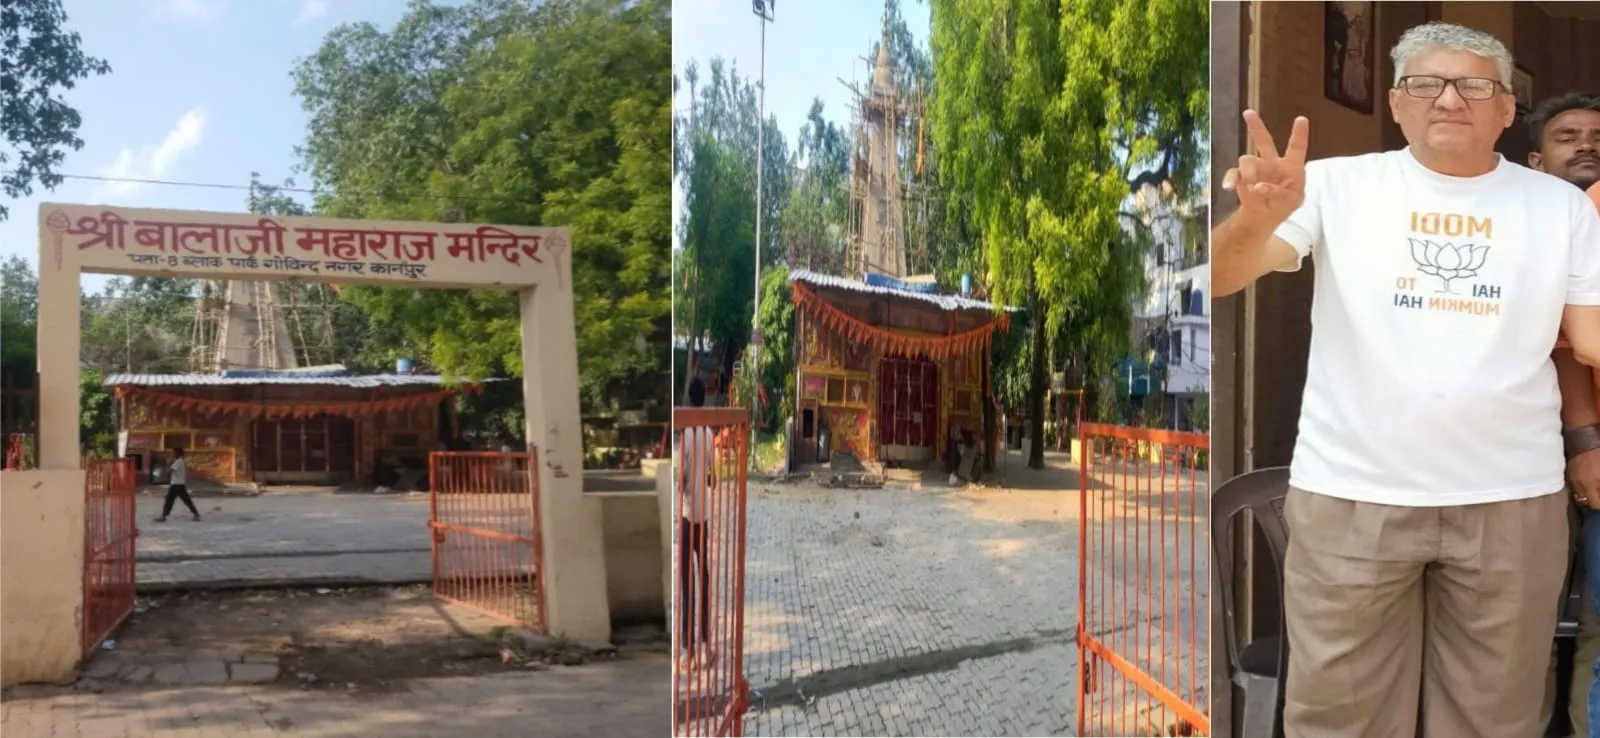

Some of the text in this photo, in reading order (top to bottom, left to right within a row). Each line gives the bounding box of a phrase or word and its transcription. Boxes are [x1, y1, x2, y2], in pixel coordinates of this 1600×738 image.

[69, 211, 544, 267] श्री बालाजी महाराज मन्दिर
[227, 255, 259, 269] पार्क
[263, 255, 320, 274] गोविन्द
[325, 260, 364, 275] नगर
